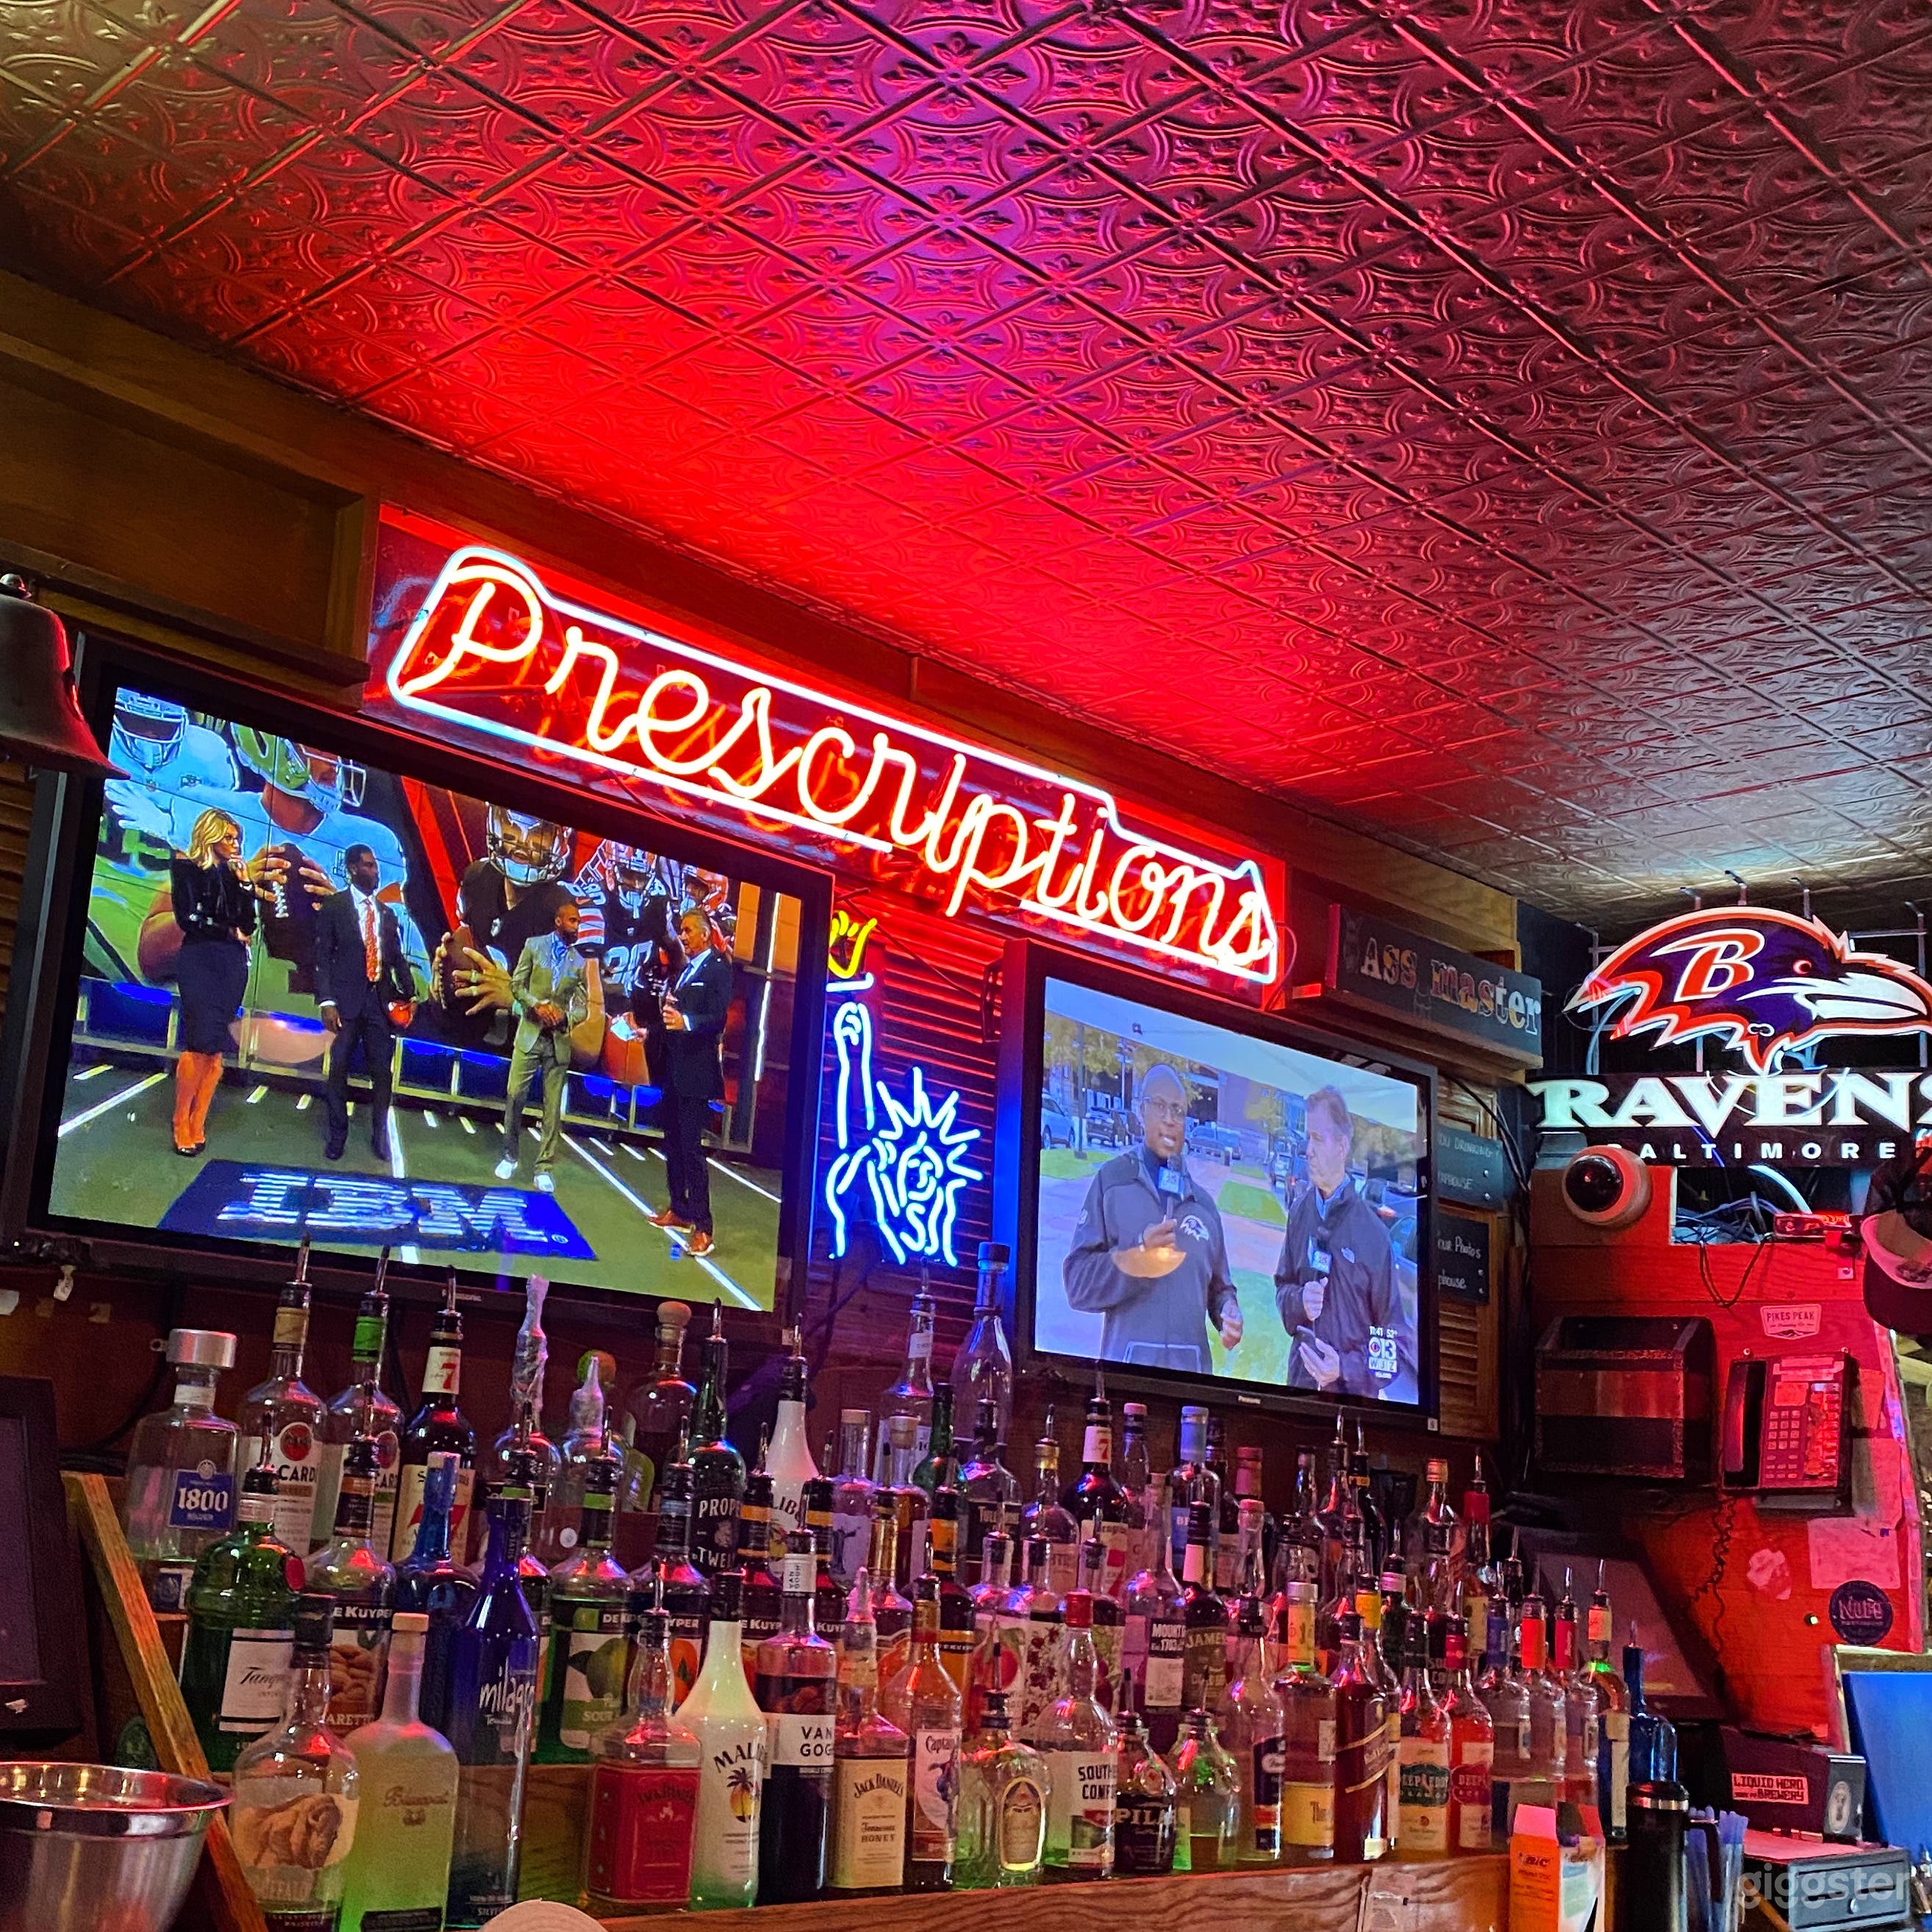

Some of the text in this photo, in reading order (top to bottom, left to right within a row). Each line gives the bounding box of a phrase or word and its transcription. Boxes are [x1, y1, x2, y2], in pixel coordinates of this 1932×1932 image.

[400, 564, 1275, 968] Prescriptions
[1430, 958, 1541, 1036] master
[1607, 1142, 1895, 1160] ALTIMORE
[217, 1172, 549, 1243] IBM
[178, 1487, 228, 1513] 1800
[854, 1781, 877, 1798] JACK
[1734, 1775, 1774, 1789] LIQUID
[861, 1833, 895, 1843] HONEY
[1524, 1856, 1551, 1868] BIC
